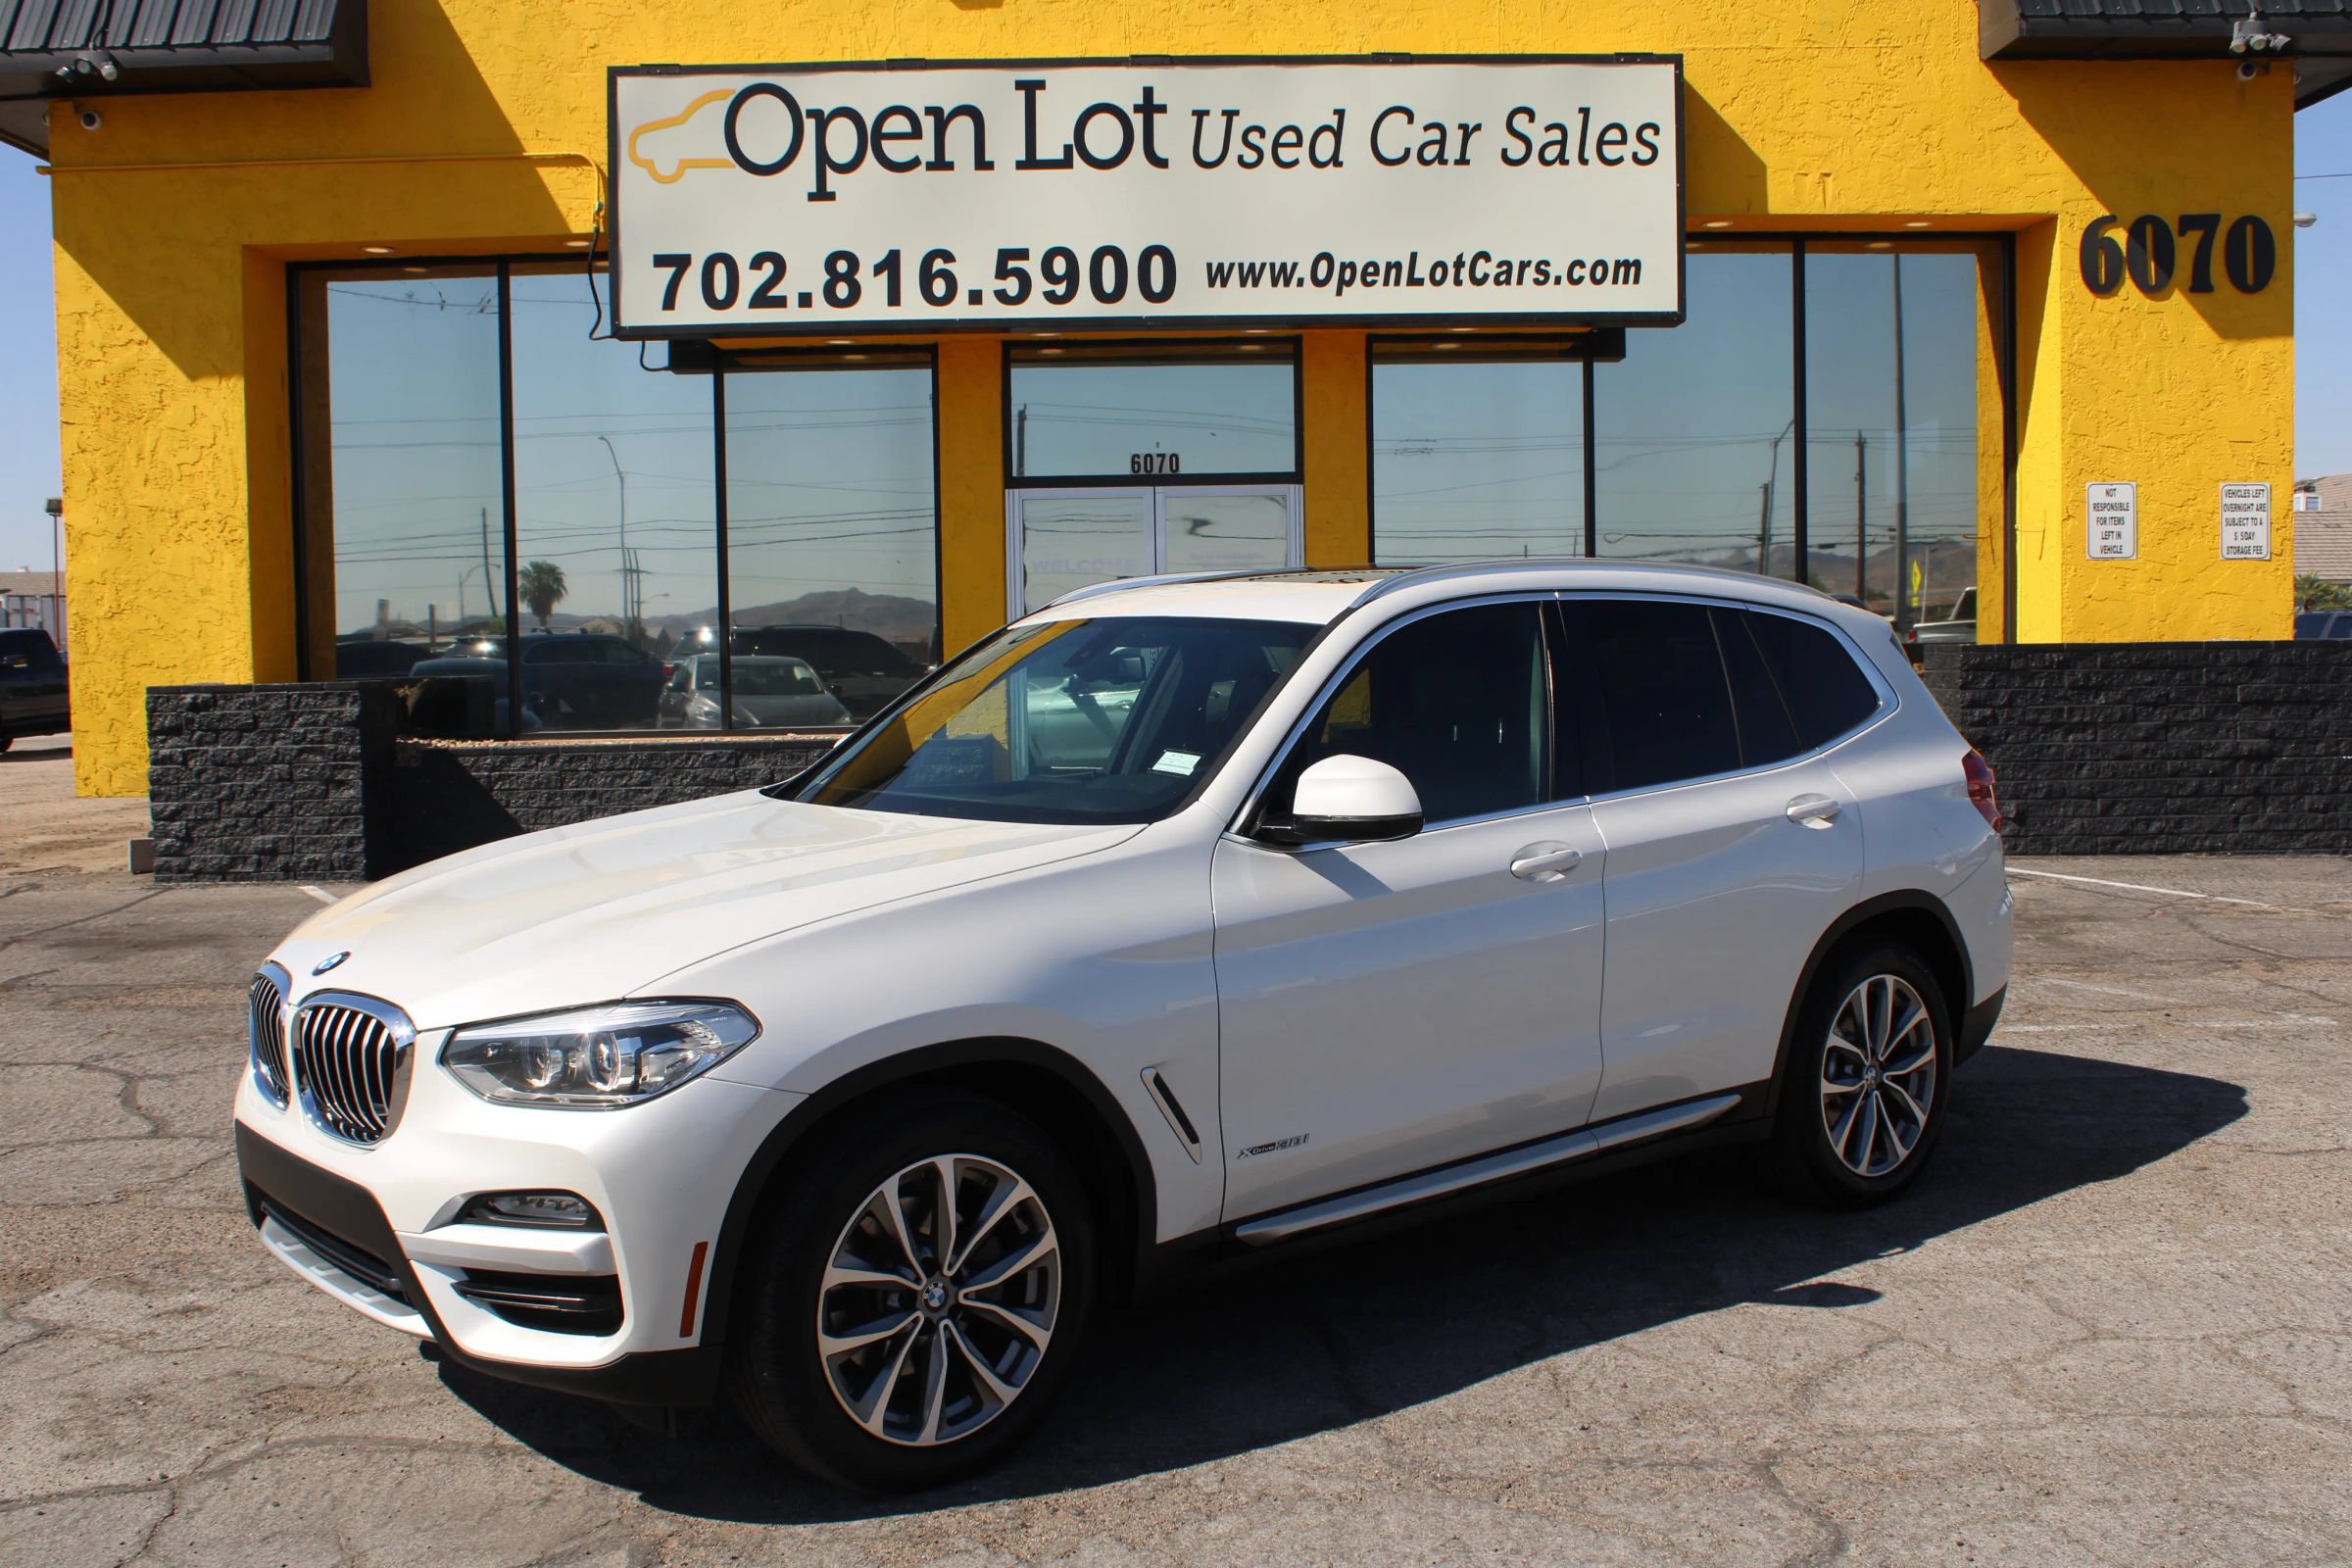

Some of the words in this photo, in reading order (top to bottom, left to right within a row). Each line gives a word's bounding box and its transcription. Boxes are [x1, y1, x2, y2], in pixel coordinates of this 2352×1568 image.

[723, 81, 994, 202] Open
[1015, 79, 1169, 171] Lot
[1191, 108, 1347, 170] Used
[1371, 105, 1483, 167] Car
[1500, 106, 1660, 168] Sales
[2080, 214, 2277, 296] 6070
[653, 244, 1177, 312] 702.816.5900
[1205, 250, 1642, 297] www.OpenLotCars.com
[1130, 453, 1180, 474] 6070
[2105, 488, 2117, 498] NOT
[2225, 489, 2250, 499] VEHICLES
[2252, 489, 2265, 499] LEFT
[2092, 502, 2130, 512] RESPONSIBLE
[2224, 503, 2254, 513] OVERNIGHT
[2255, 503, 2267, 513] ARE
[2096, 516, 2107, 526] FOR
[2109, 516, 2126, 526] ITEMS
[2225, 517, 2249, 526] SUBJECT
[2250, 517, 2258, 526] TO
[2101, 531, 2114, 540] LEFT
[2116, 531, 2122, 540] IN
[2100, 545, 2123, 555] VEHICLE
[2226, 546, 2251, 555] STORAGE
[2252, 546, 2263, 555] FEE
